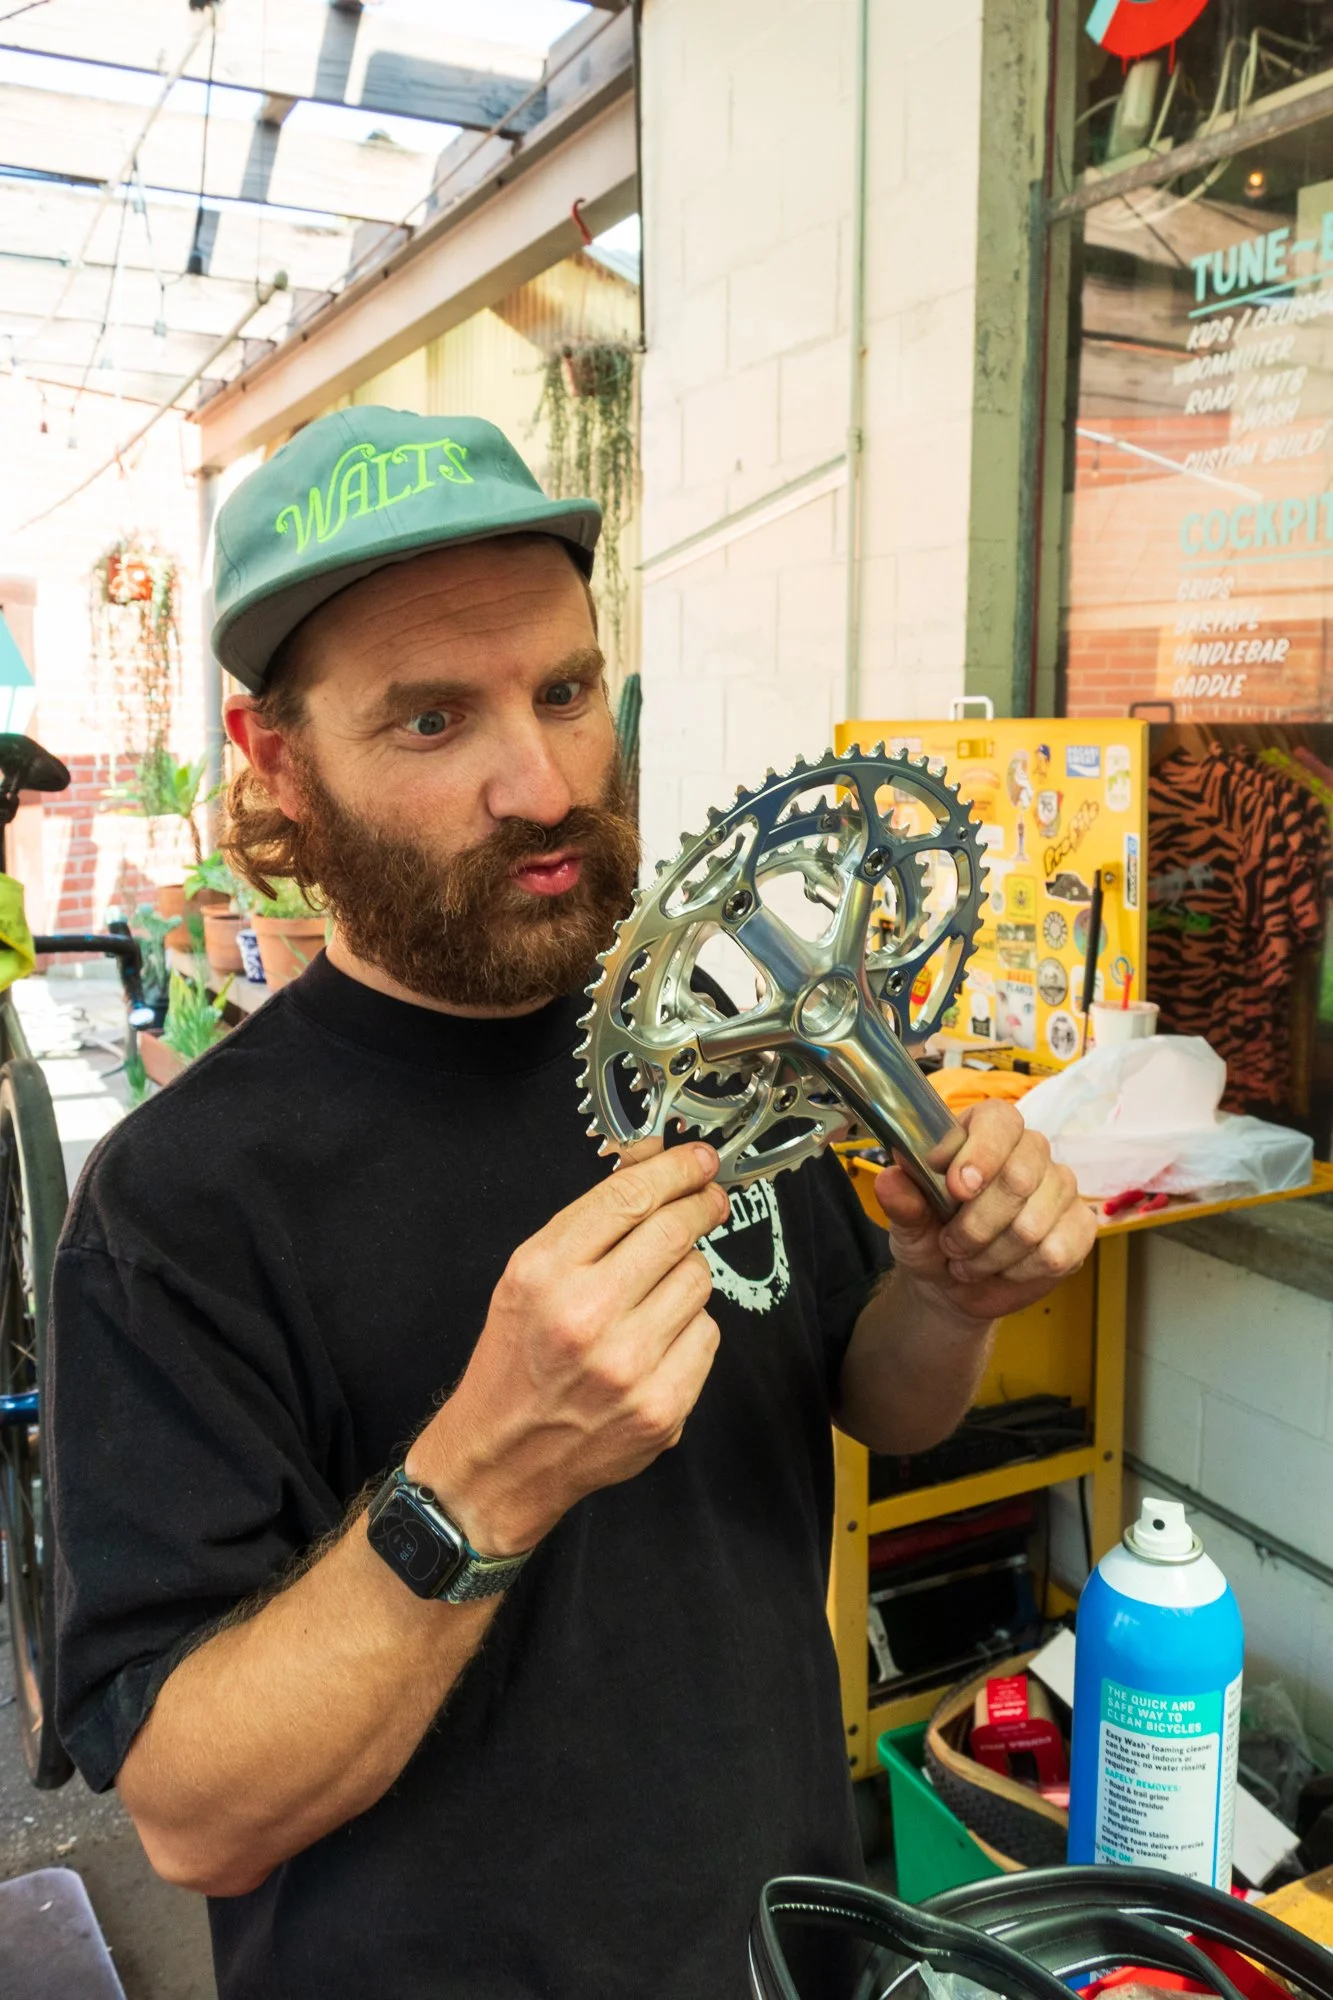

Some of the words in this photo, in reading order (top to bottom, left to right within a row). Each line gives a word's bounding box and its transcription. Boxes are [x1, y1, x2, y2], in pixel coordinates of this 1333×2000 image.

[1186, 315, 1234, 351] KIDS
[1185, 382, 1239, 415] ROAD
[1173, 638, 1290, 666] HANDLEBAR
[1171, 674, 1248, 698] SADDLE
[1107, 1697, 1134, 1715] SAFE
[1138, 1708, 1163, 1721] WAY
[1168, 1712, 1183, 1722] TO
[1108, 1685, 1127, 1700] THE
[1131, 1695, 1167, 1711] QUICK
[1172, 1701, 1196, 1711] AND
[1107, 1708, 1142, 1728] CLEAN
[1146, 1721, 1202, 1734] BICYCLES
[1105, 1740, 1118, 1749] can
[1120, 1745, 1129, 1754] be
[1131, 1750, 1150, 1760] used
[1152, 1753, 1182, 1762] indoors
[1106, 1729, 1122, 1742] Easy
[1151, 1744, 1184, 1754] foaming
[1105, 1767, 1133, 1784] SAFELY
[1181, 1763, 1206, 1771] rinsing
[1109, 1780, 1125, 1792] Road
[1133, 1788, 1147, 1798] trail
[1149, 1794, 1169, 1802] grime
[1109, 1789, 1137, 1805] Nutrition
[1138, 1801, 1163, 1810] residue
[1108, 1798, 1117, 1807] Oil
[1118, 1803, 1147, 1817] splatters
[1107, 1817, 1147, 1836] Perspiration
[1149, 1831, 1169, 1839] stains
[1122, 1814, 1139, 1825] glaze
[1102, 1825, 1128, 1843] Clinging
[1130, 1838, 1148, 1847] foam
[1150, 1841, 1179, 1850] delivers
[1102, 1844, 1117, 1857] USE
